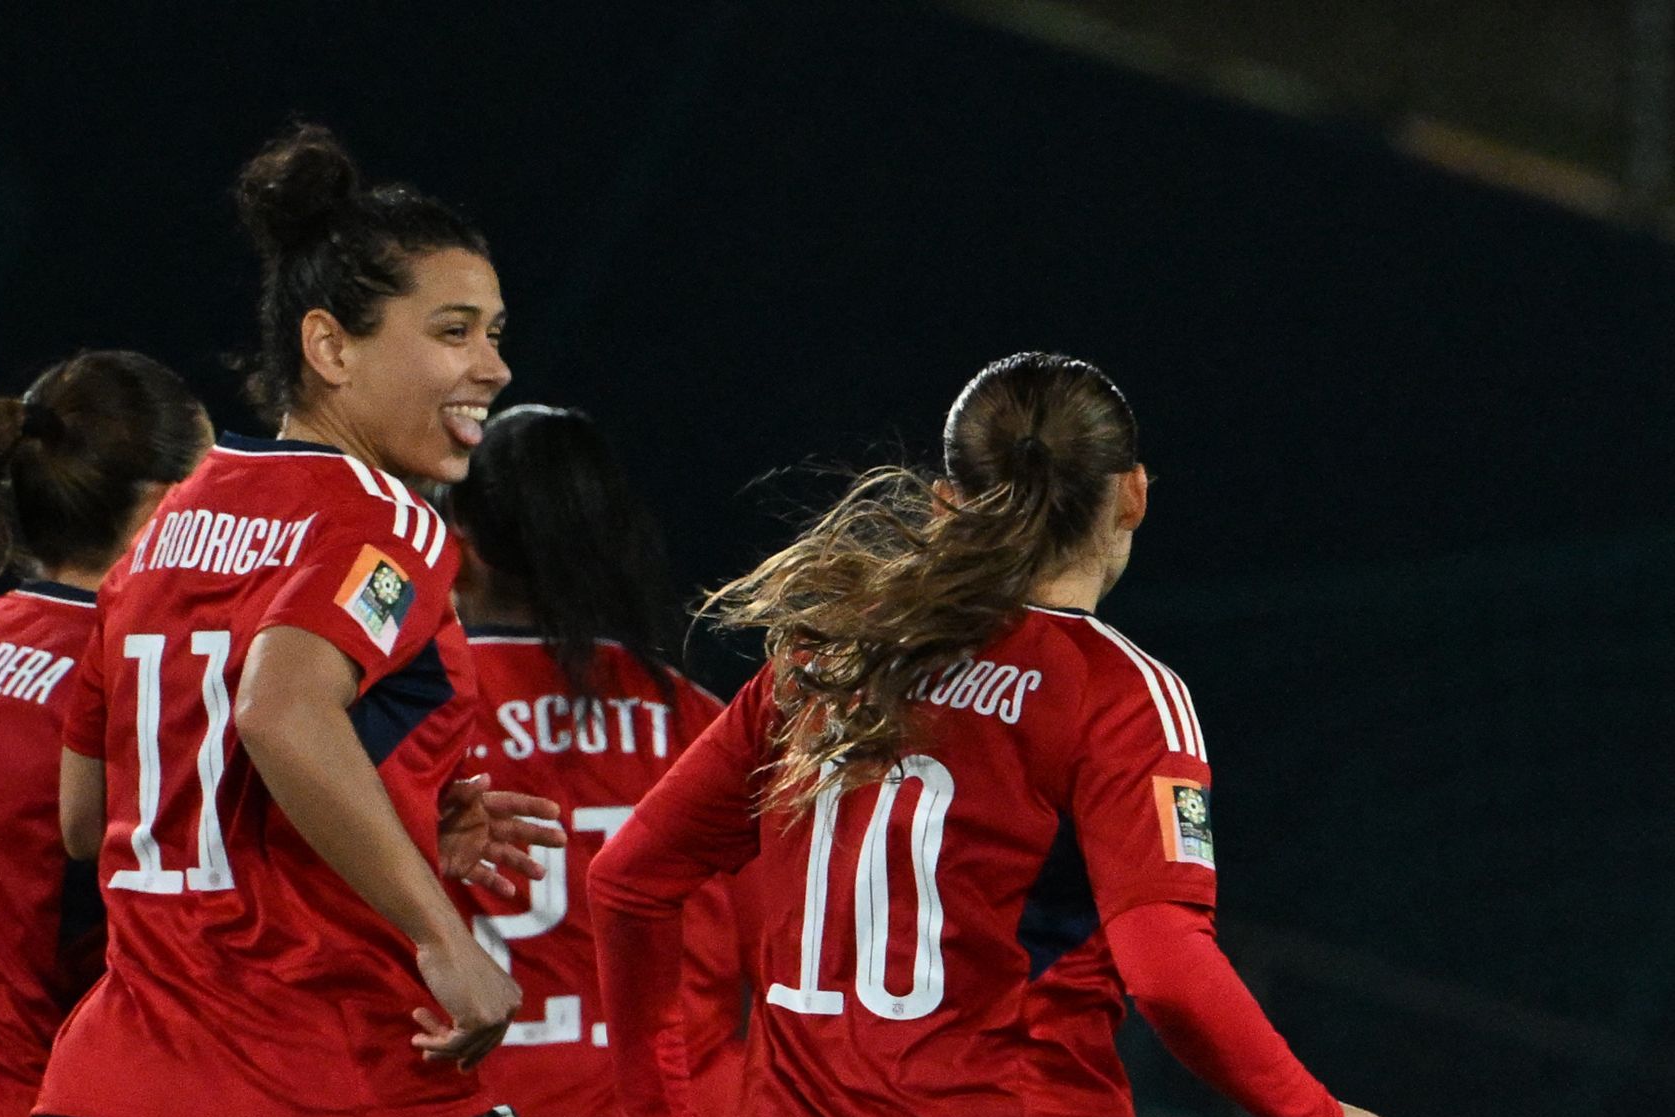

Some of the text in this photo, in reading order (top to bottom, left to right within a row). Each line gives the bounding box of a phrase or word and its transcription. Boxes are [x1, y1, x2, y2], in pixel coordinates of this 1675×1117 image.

[107, 630, 236, 894] 11
[496, 694, 670, 760] SCOTT
[766, 754, 956, 1020] 10
